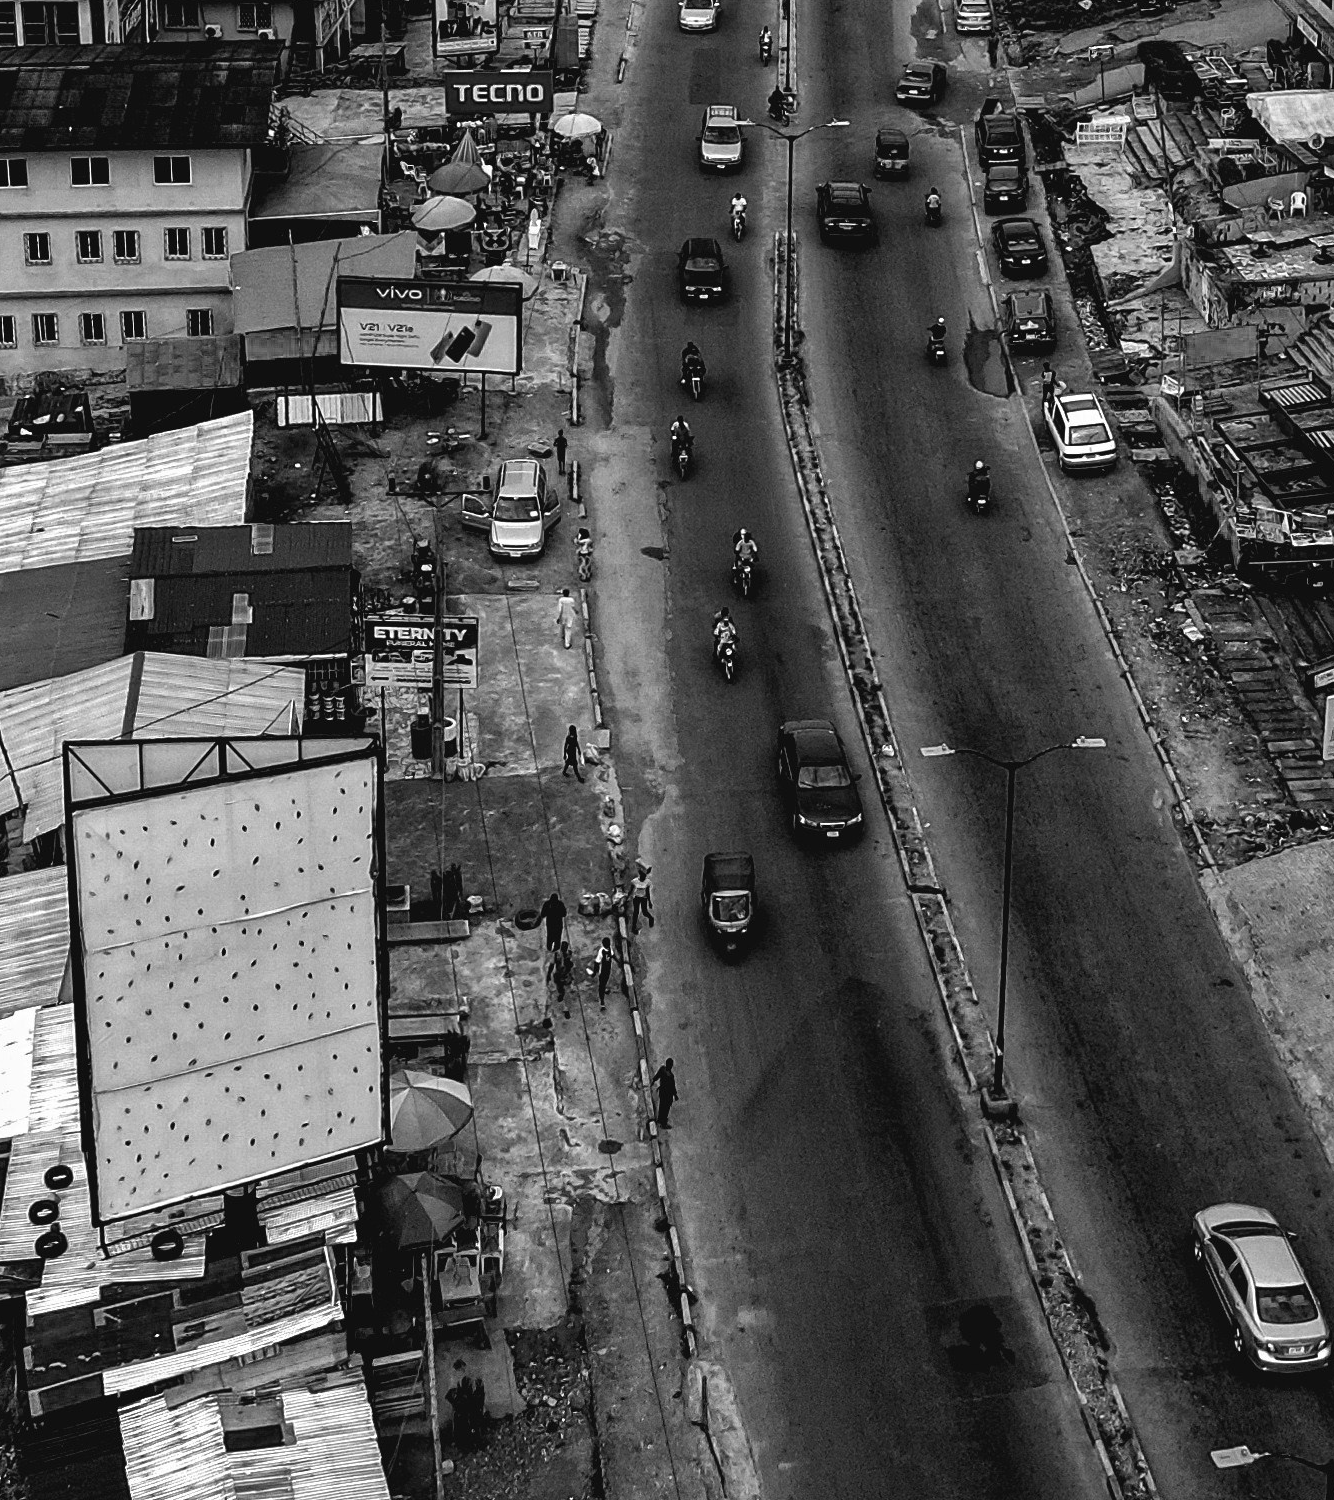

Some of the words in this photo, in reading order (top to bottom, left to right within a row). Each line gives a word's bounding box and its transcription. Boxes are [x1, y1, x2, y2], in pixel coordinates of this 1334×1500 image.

[453, 84, 544, 102] TECNO
[376, 285, 423, 299] vivo
[359, 322, 380, 332] V21
[373, 626, 467, 641] ETERNTY
